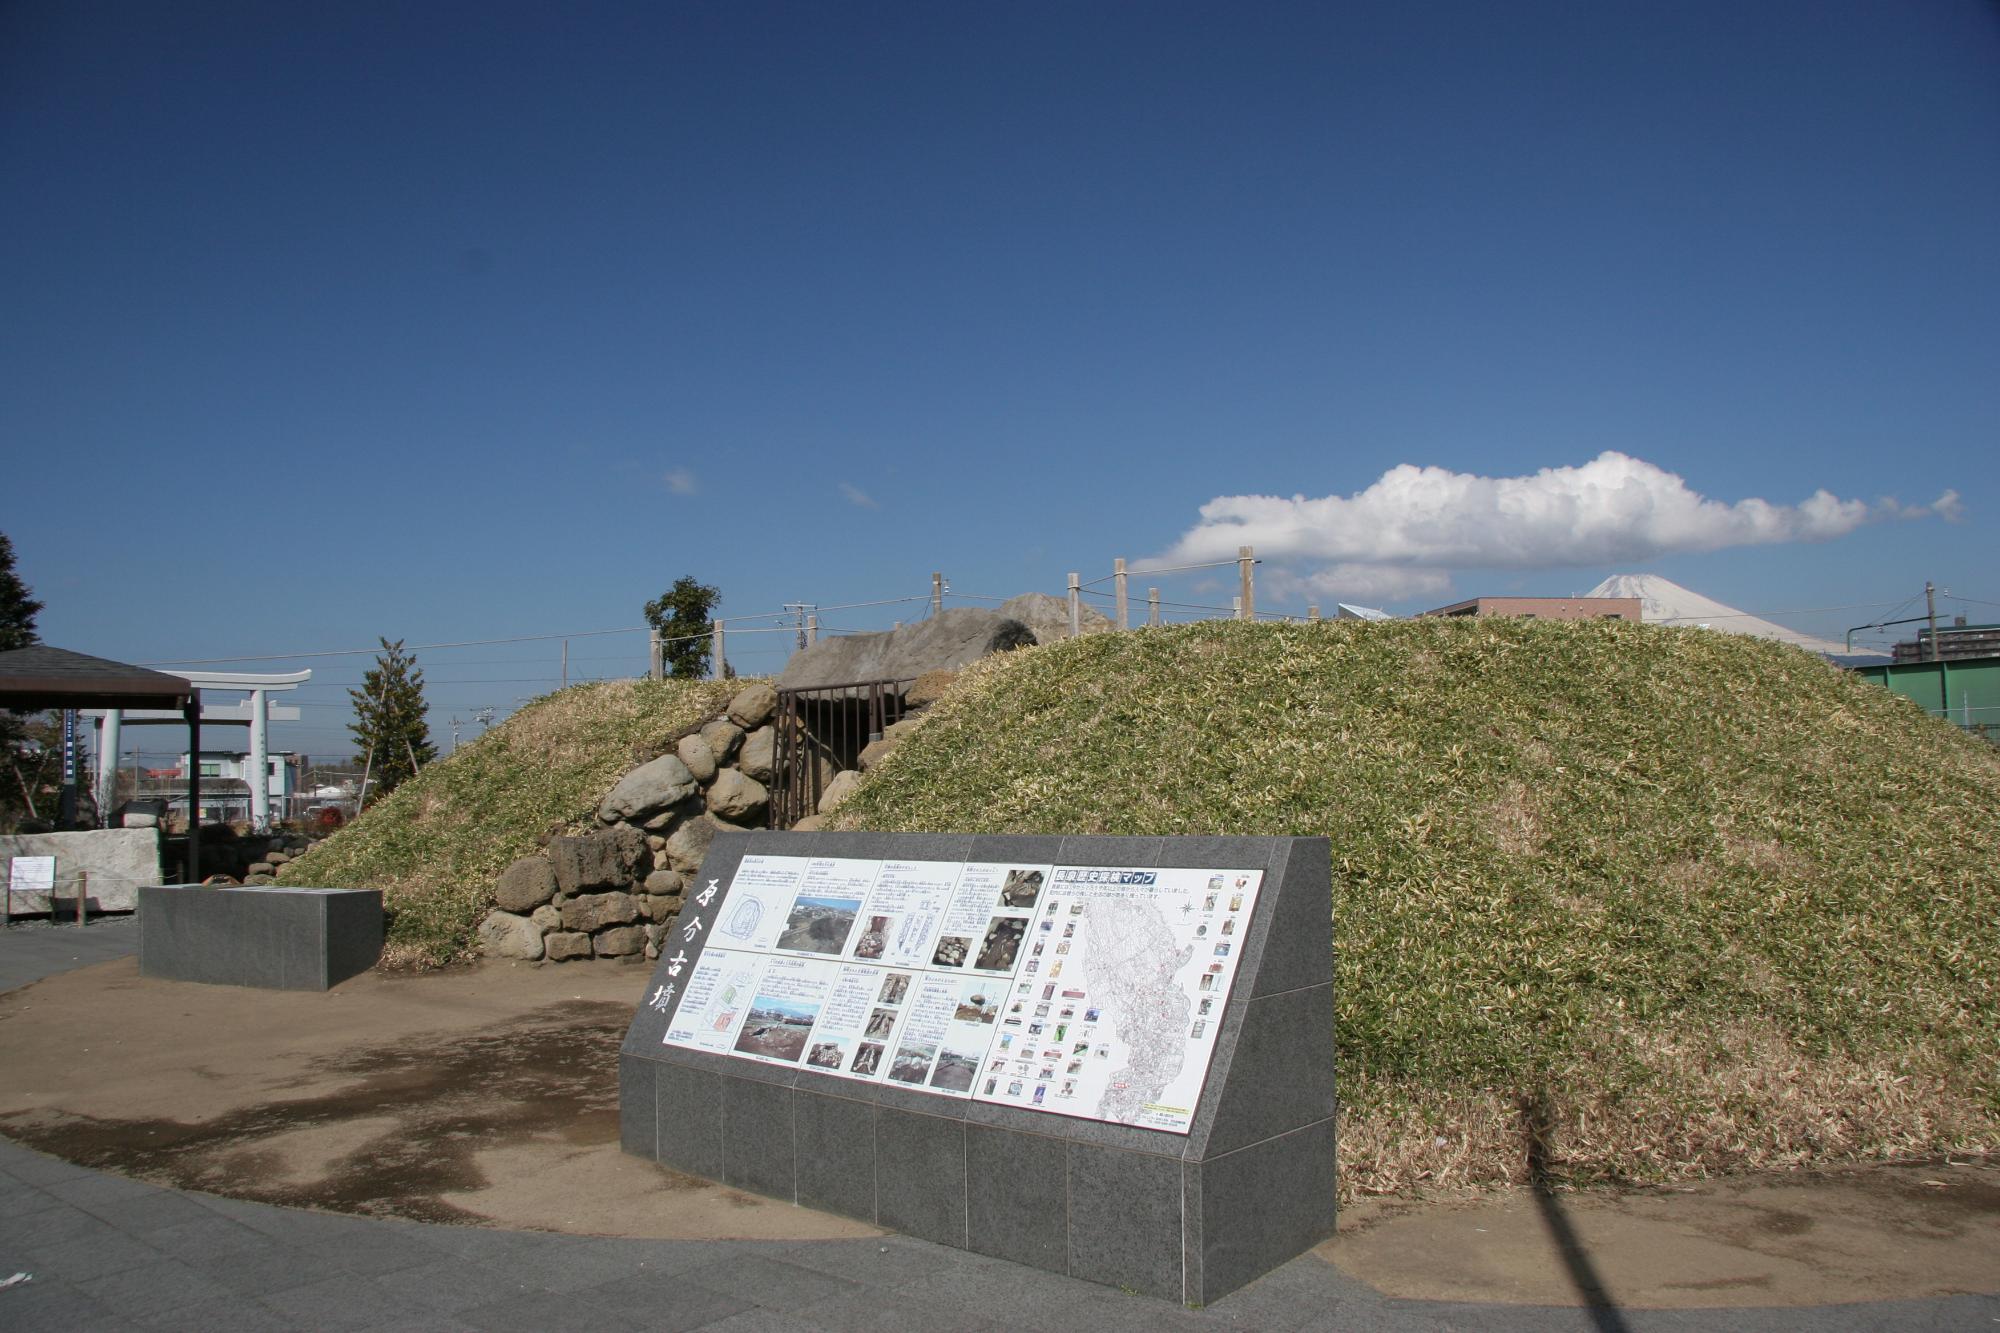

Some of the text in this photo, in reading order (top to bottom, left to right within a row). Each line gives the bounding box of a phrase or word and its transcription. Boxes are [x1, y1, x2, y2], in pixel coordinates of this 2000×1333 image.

[1056, 870, 1156, 884] 長泉歴史探検マップ
[649, 878, 720, 1014] 原分古墳
